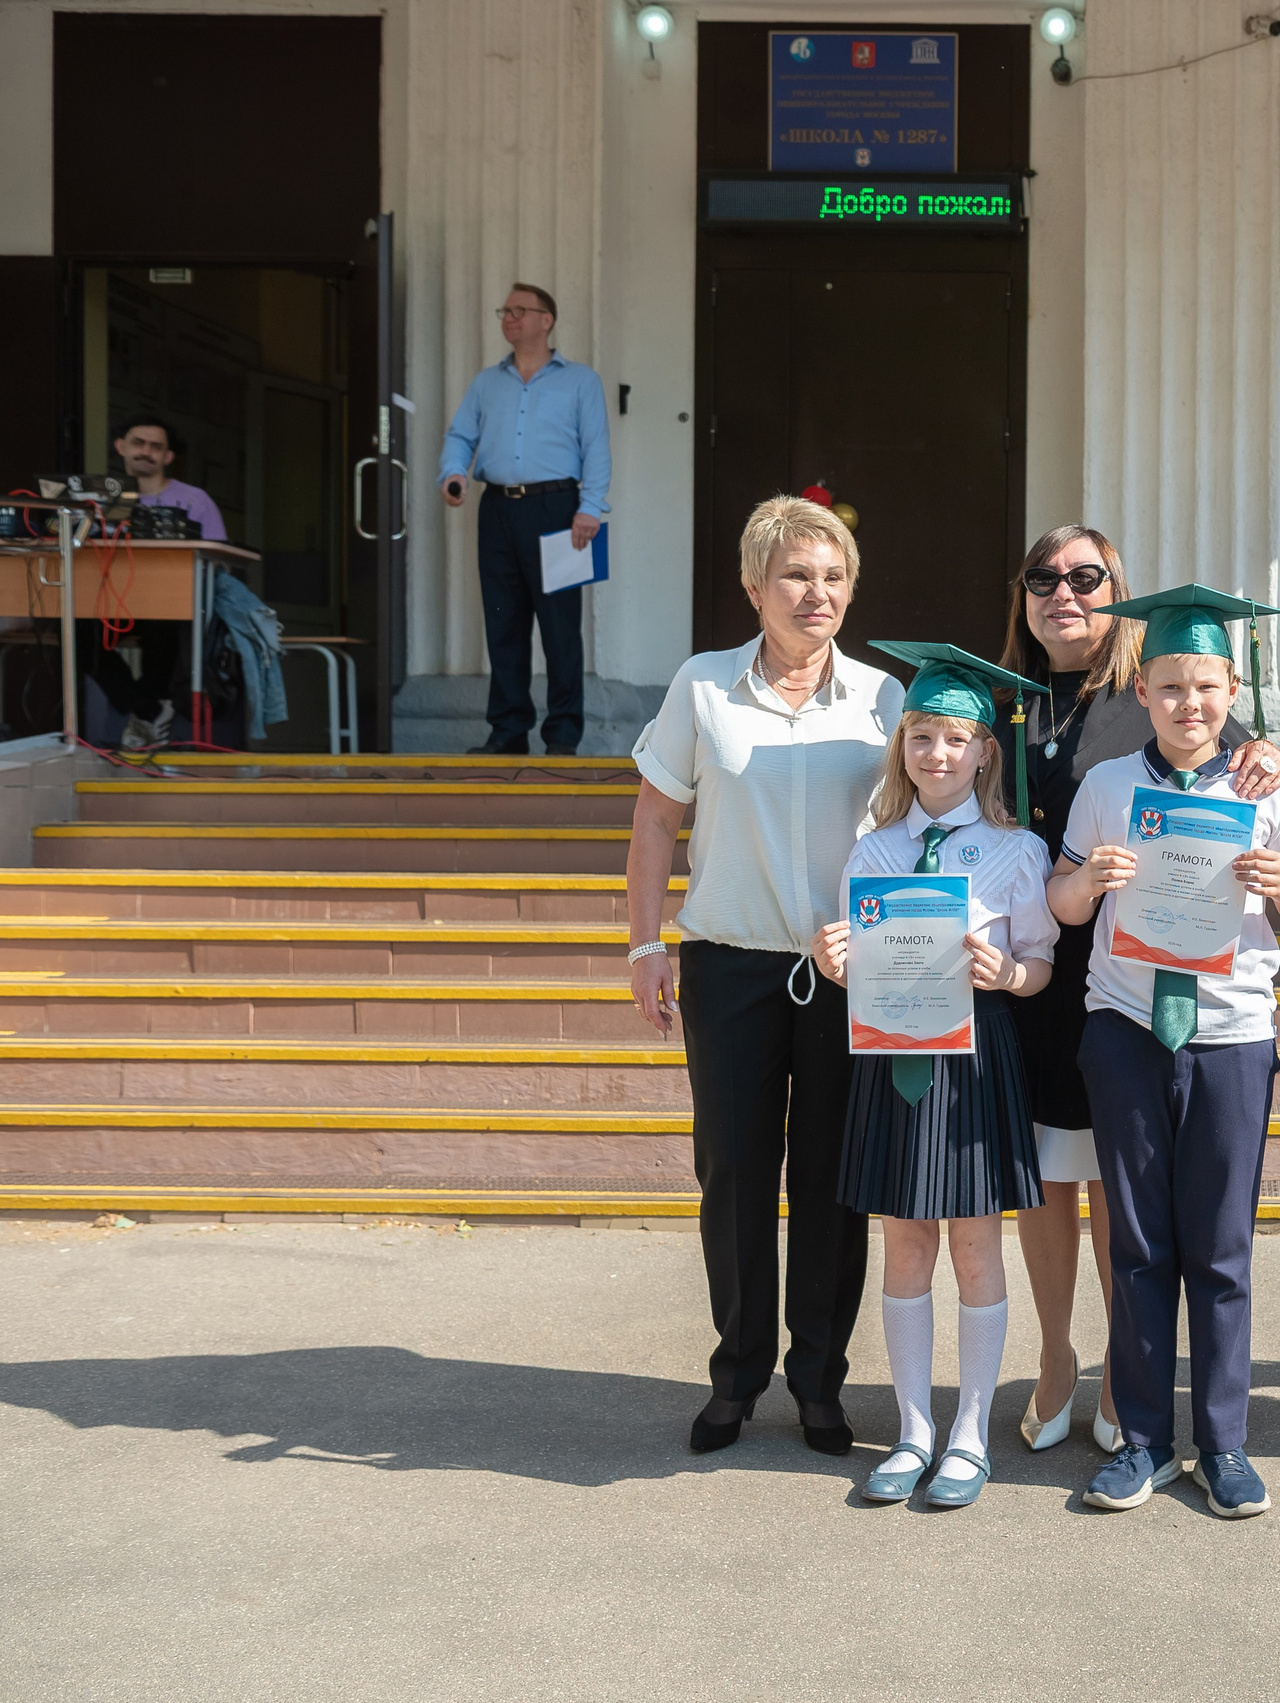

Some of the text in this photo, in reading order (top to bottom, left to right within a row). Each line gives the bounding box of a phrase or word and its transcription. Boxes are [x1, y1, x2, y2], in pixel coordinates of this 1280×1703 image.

[819, 187, 907, 221] Добро
[1161, 850, 1213, 868] ГРАМОТА
[884, 936, 934, 944] ГРАМОТА
